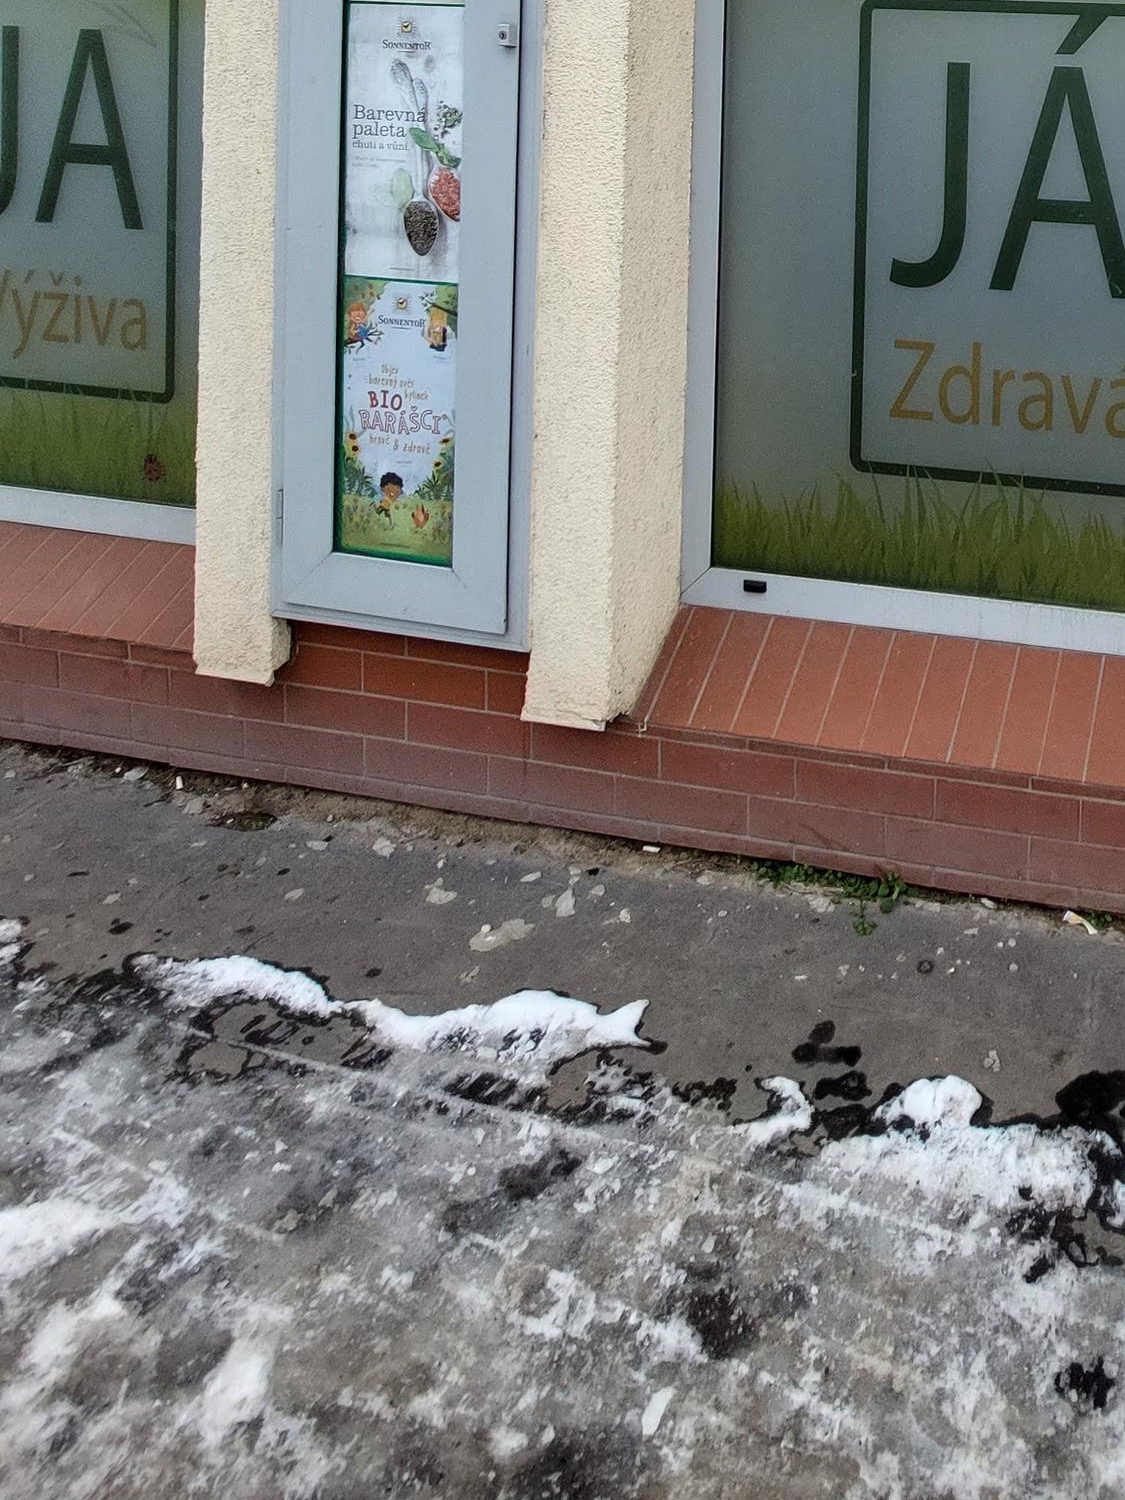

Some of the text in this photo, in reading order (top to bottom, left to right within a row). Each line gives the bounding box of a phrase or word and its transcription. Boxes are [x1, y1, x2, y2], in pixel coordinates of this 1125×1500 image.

[353, 104, 426, 123] Barevná
[352, 121, 407, 139] paleta
[368, 389, 403, 411] BIO
